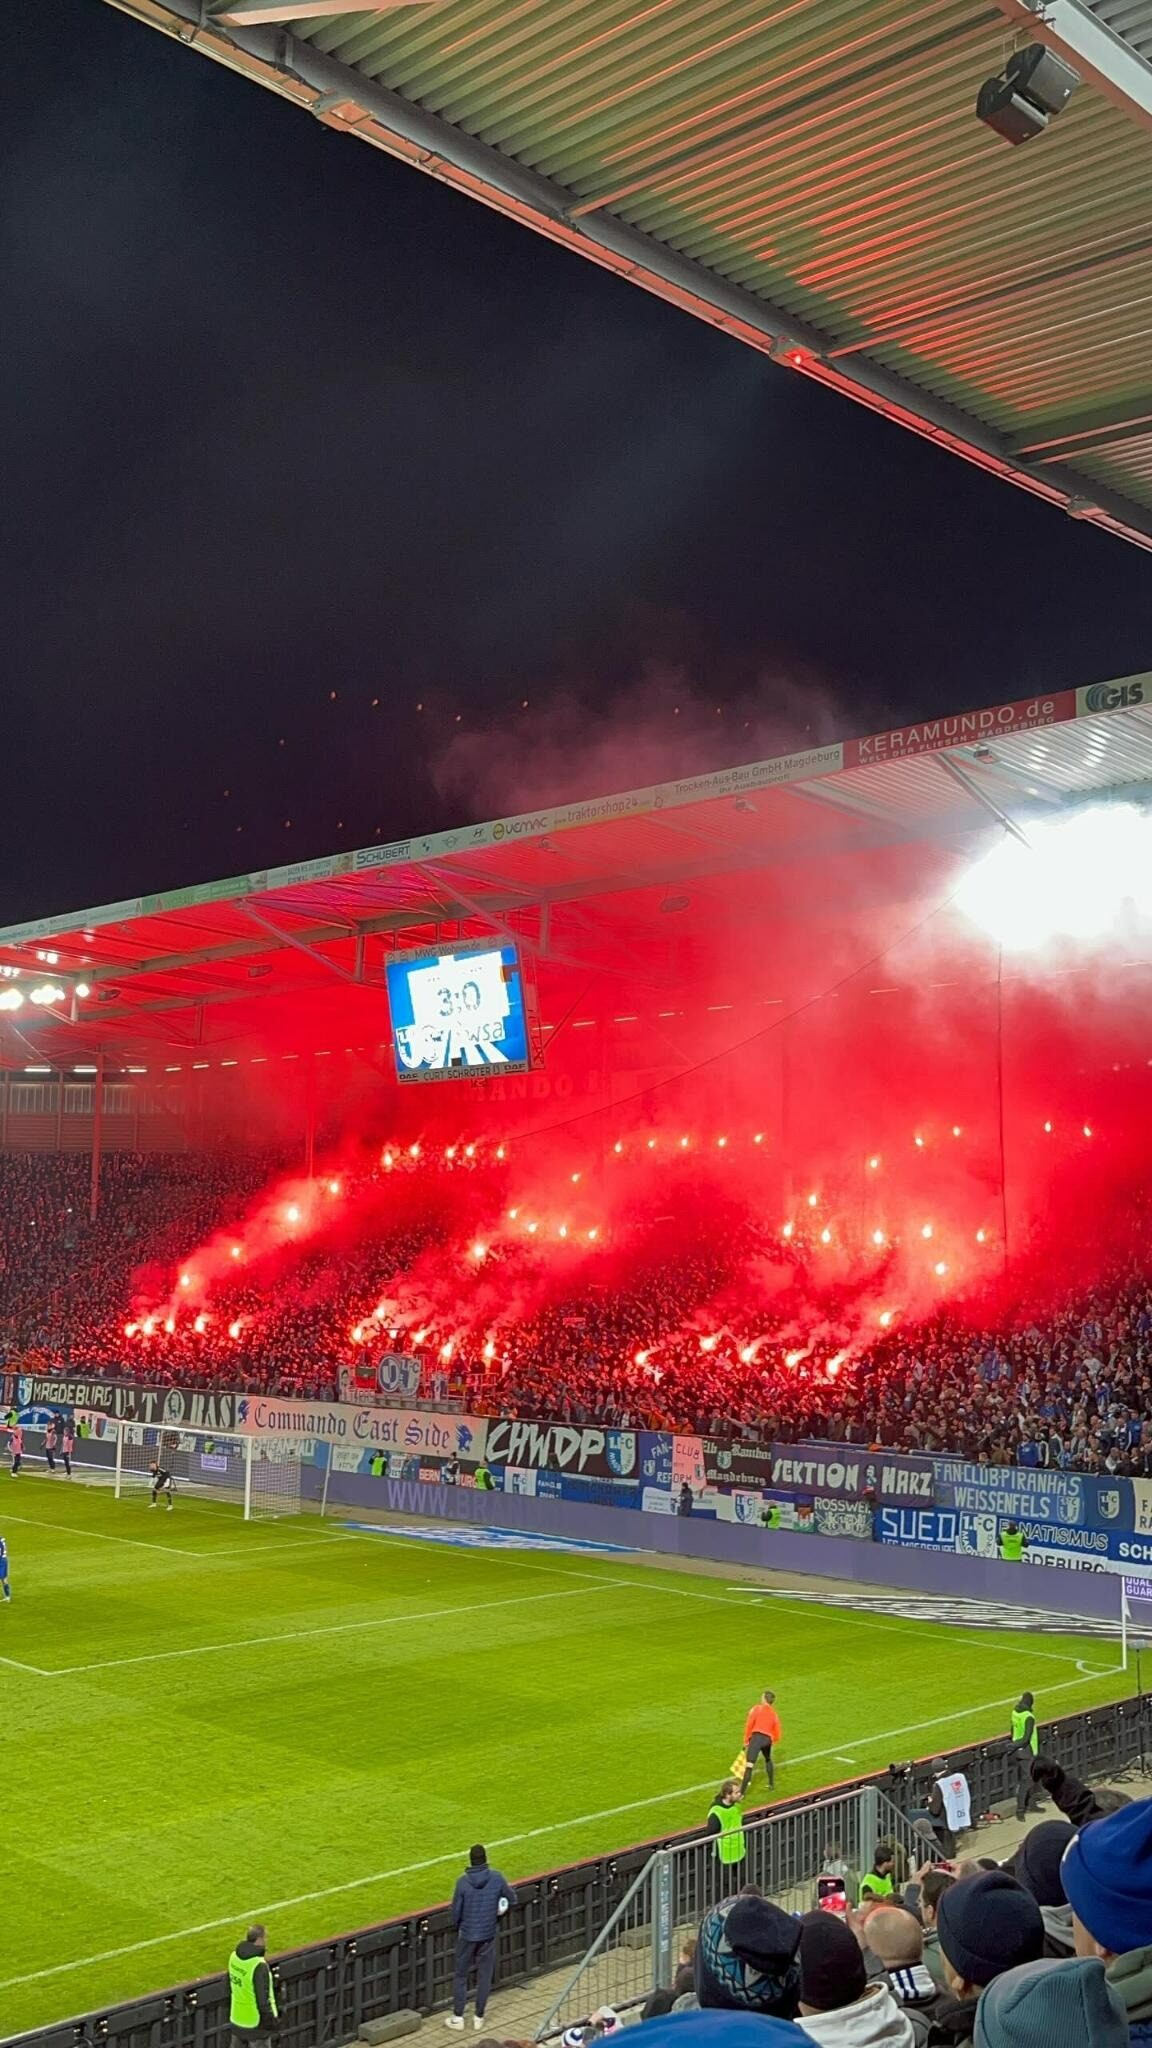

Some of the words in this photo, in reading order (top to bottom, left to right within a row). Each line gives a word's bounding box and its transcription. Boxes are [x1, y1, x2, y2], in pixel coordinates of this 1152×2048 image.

[1101, 682, 1144, 709] GIS
[858, 700, 1055, 756] KERAMUNDO.de
[977, 715, 1055, 739] MAGDEBURG
[752, 762, 781, 777] GmbH
[784, 749, 840, 770] Magdeburg
[356, 845, 410, 865] SCHUBERT
[437, 981, 481, 1017] 3:0
[33, 1382, 113, 1406] MAGDEBURG
[254, 1403, 346, 1438] Commando
[353, 1410, 399, 1443] East
[405, 1418, 451, 1450] Side
[485, 1421, 605, 1473] CHWDP
[771, 1458, 859, 1492] SEKTION
[881, 1466, 933, 1497] HARZ
[954, 1486, 1050, 1519] WEISSENFELS
[881, 1507, 957, 1542] SUED
